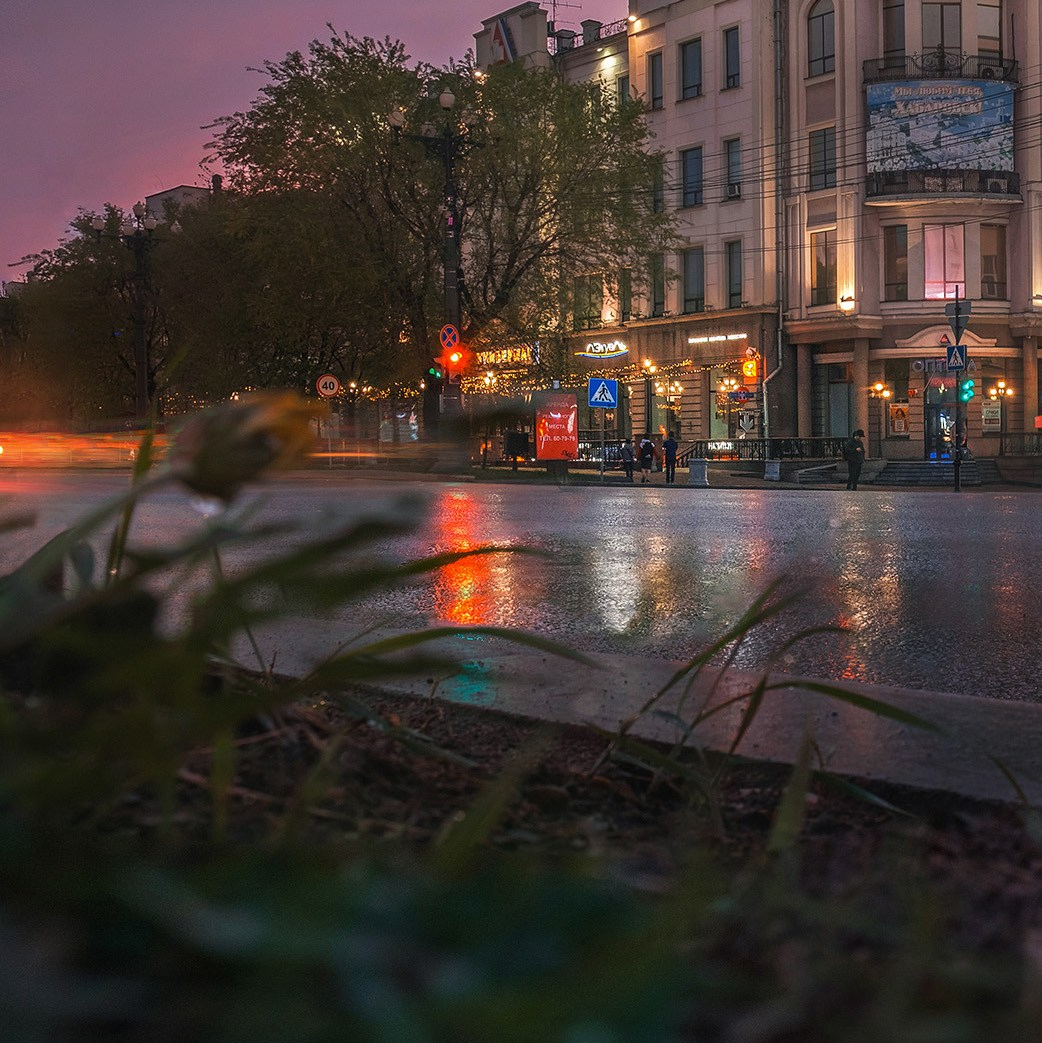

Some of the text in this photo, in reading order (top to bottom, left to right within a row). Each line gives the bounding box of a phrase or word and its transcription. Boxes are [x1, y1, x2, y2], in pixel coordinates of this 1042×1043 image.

[895, 87, 912, 95] МЫ
[911, 358, 978, 373] ОПТА
[322, 381, 335, 390] 40
